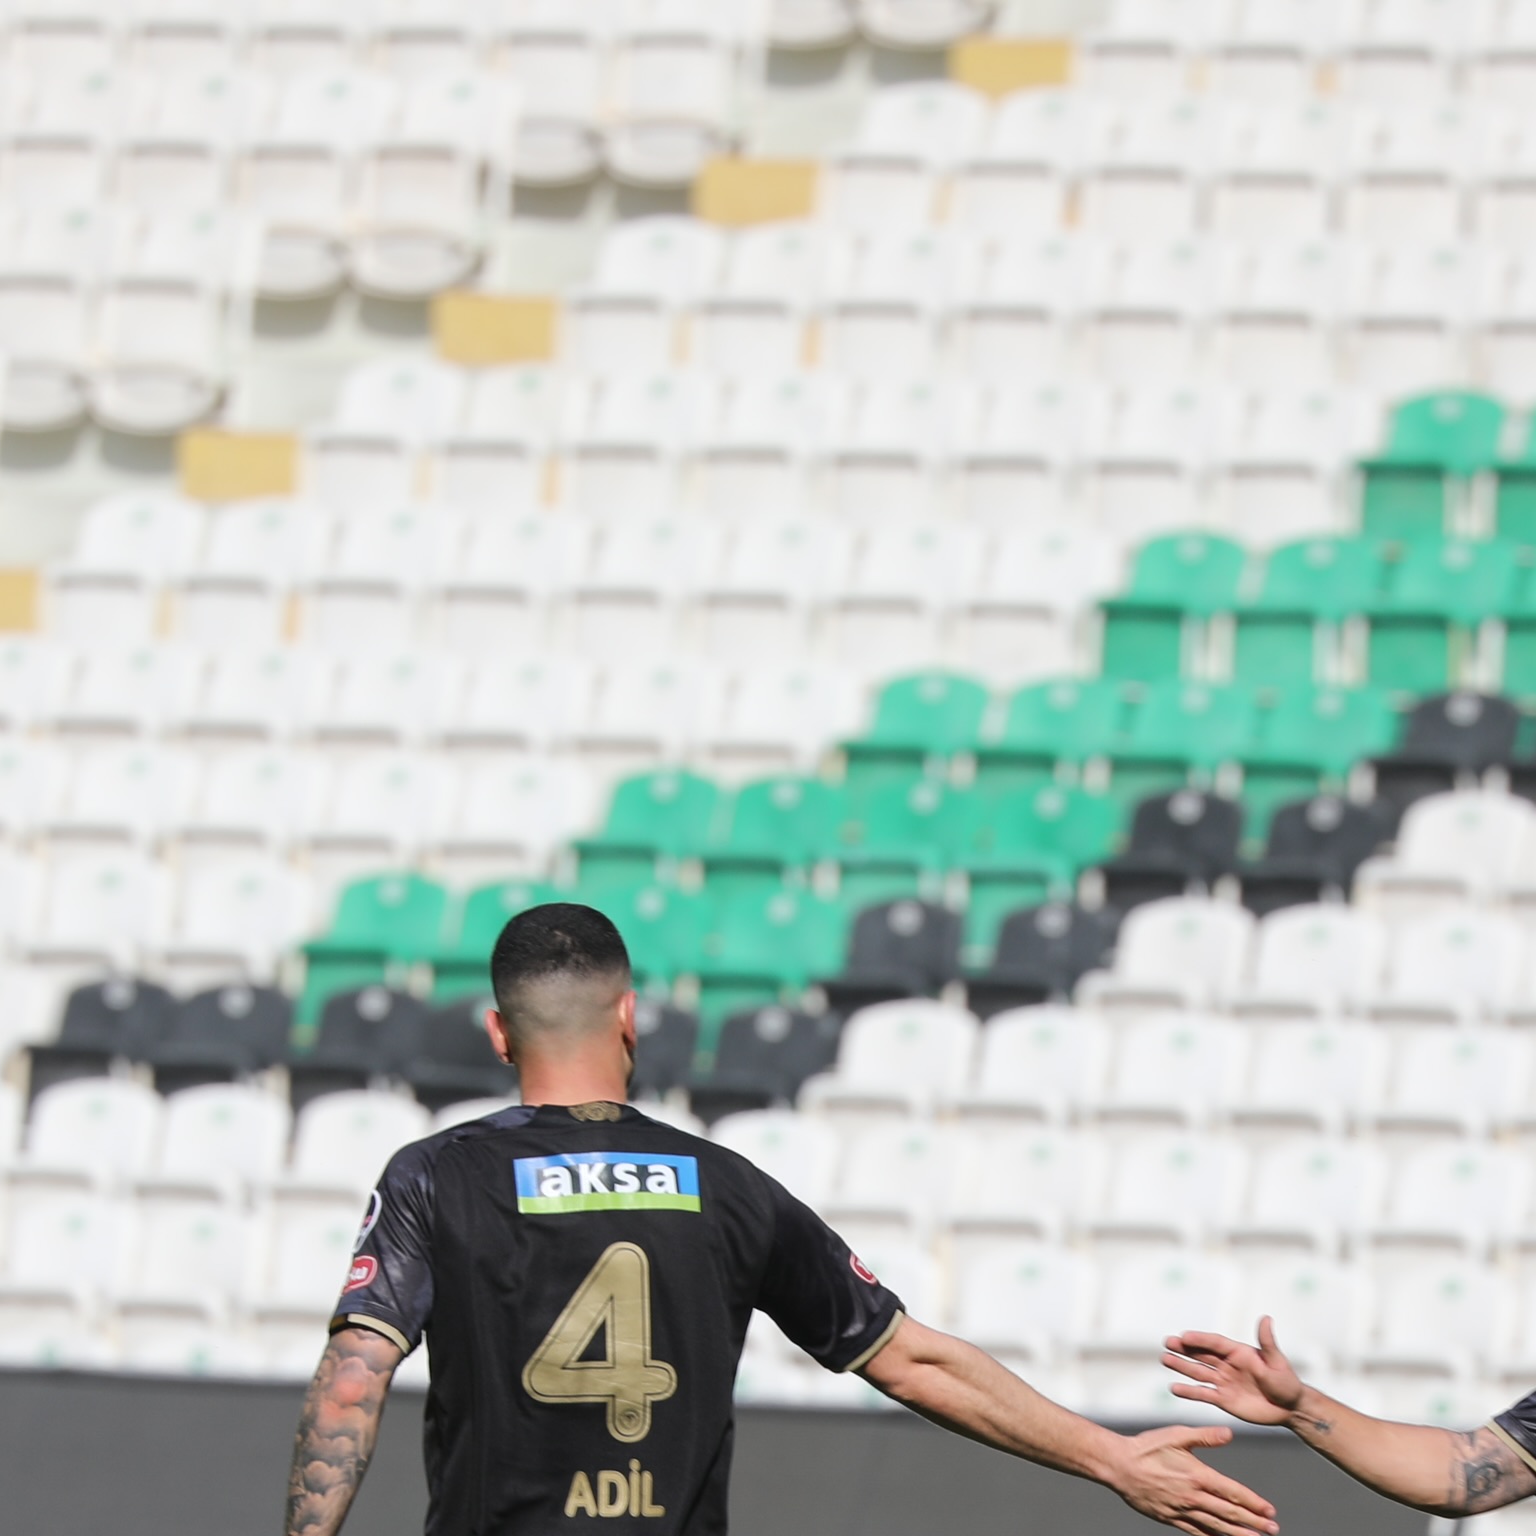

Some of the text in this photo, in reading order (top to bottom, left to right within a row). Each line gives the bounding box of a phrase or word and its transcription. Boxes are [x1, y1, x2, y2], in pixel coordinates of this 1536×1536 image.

[540, 1162, 679, 1198] aksa
[521, 1242, 677, 1443] 4
[565, 1459, 666, 1518] ADİL
